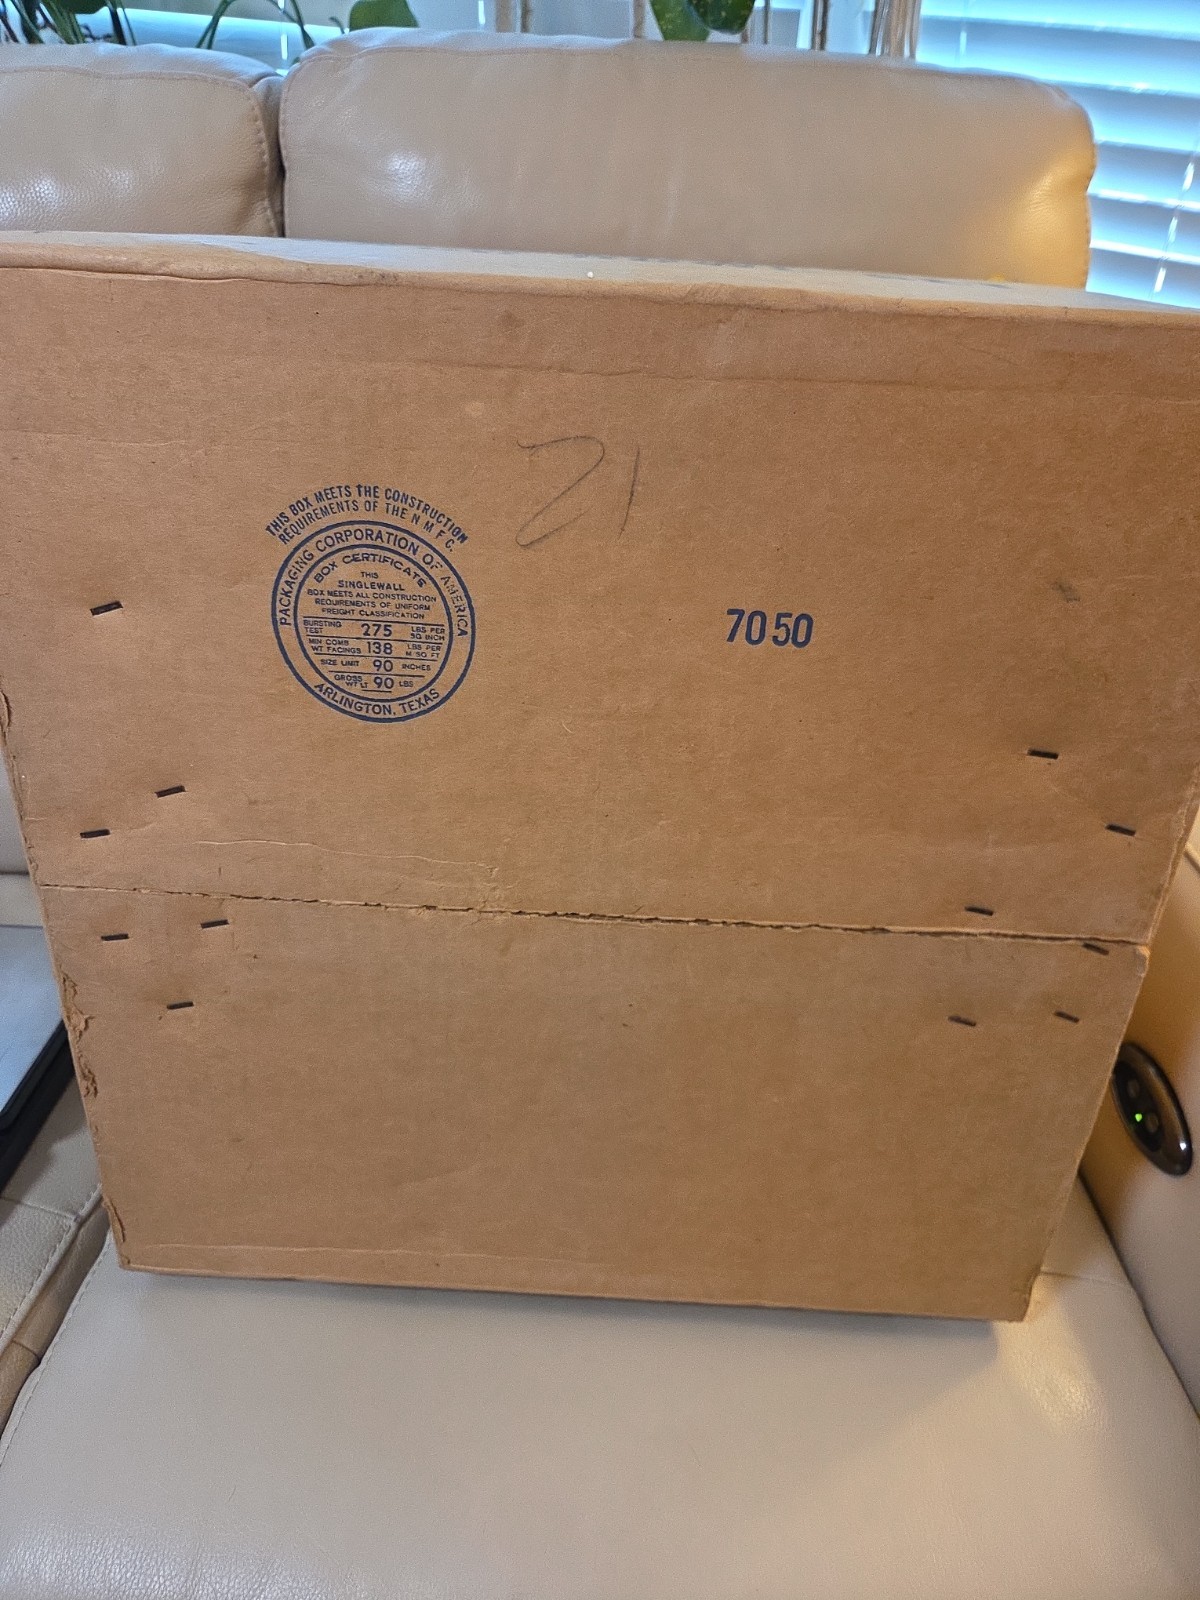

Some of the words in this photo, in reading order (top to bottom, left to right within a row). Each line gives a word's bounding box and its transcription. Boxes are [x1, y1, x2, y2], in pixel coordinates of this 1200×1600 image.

[266, 512, 291, 537] THIS
[289, 496, 313, 516] BOX
[314, 485, 351, 504] MEETS
[356, 484, 379, 498] THE
[385, 488, 468, 544] CONSTRUCTION
[278, 500, 359, 545] REQUIREMENTS
[365, 501, 378, 512] OF
[385, 503, 406, 519] THE
[411, 514, 421, 524] N
[423, 521, 435, 533] M
[436, 531, 443, 539] F
[313, 561, 338, 584] BOX
[342, 552, 427, 588] CERTIFICATE
[280, 548, 314, 626] PACKAGING
[316, 528, 419, 556] CORPORATION
[422, 553, 442, 570] OF
[440, 575, 468, 637] AMERICA
[338, 580, 405, 591] SINGLEWALL
[315, 598, 376, 608] REQUIREMENTS
[373, 593, 436, 602] CONSTRUCTION
[359, 610, 425, 619] CLASSIFICATION
[361, 623, 392, 637] 275
[727, 609, 813, 648] 7050
[367, 642, 393, 655] 138
[373, 660, 393, 672] 90
[334, 674, 362, 682] GROSS
[373, 677, 394, 689] 90
[314, 682, 396, 716] ARLINGTON,
[399, 688, 440, 714] TEXAS
